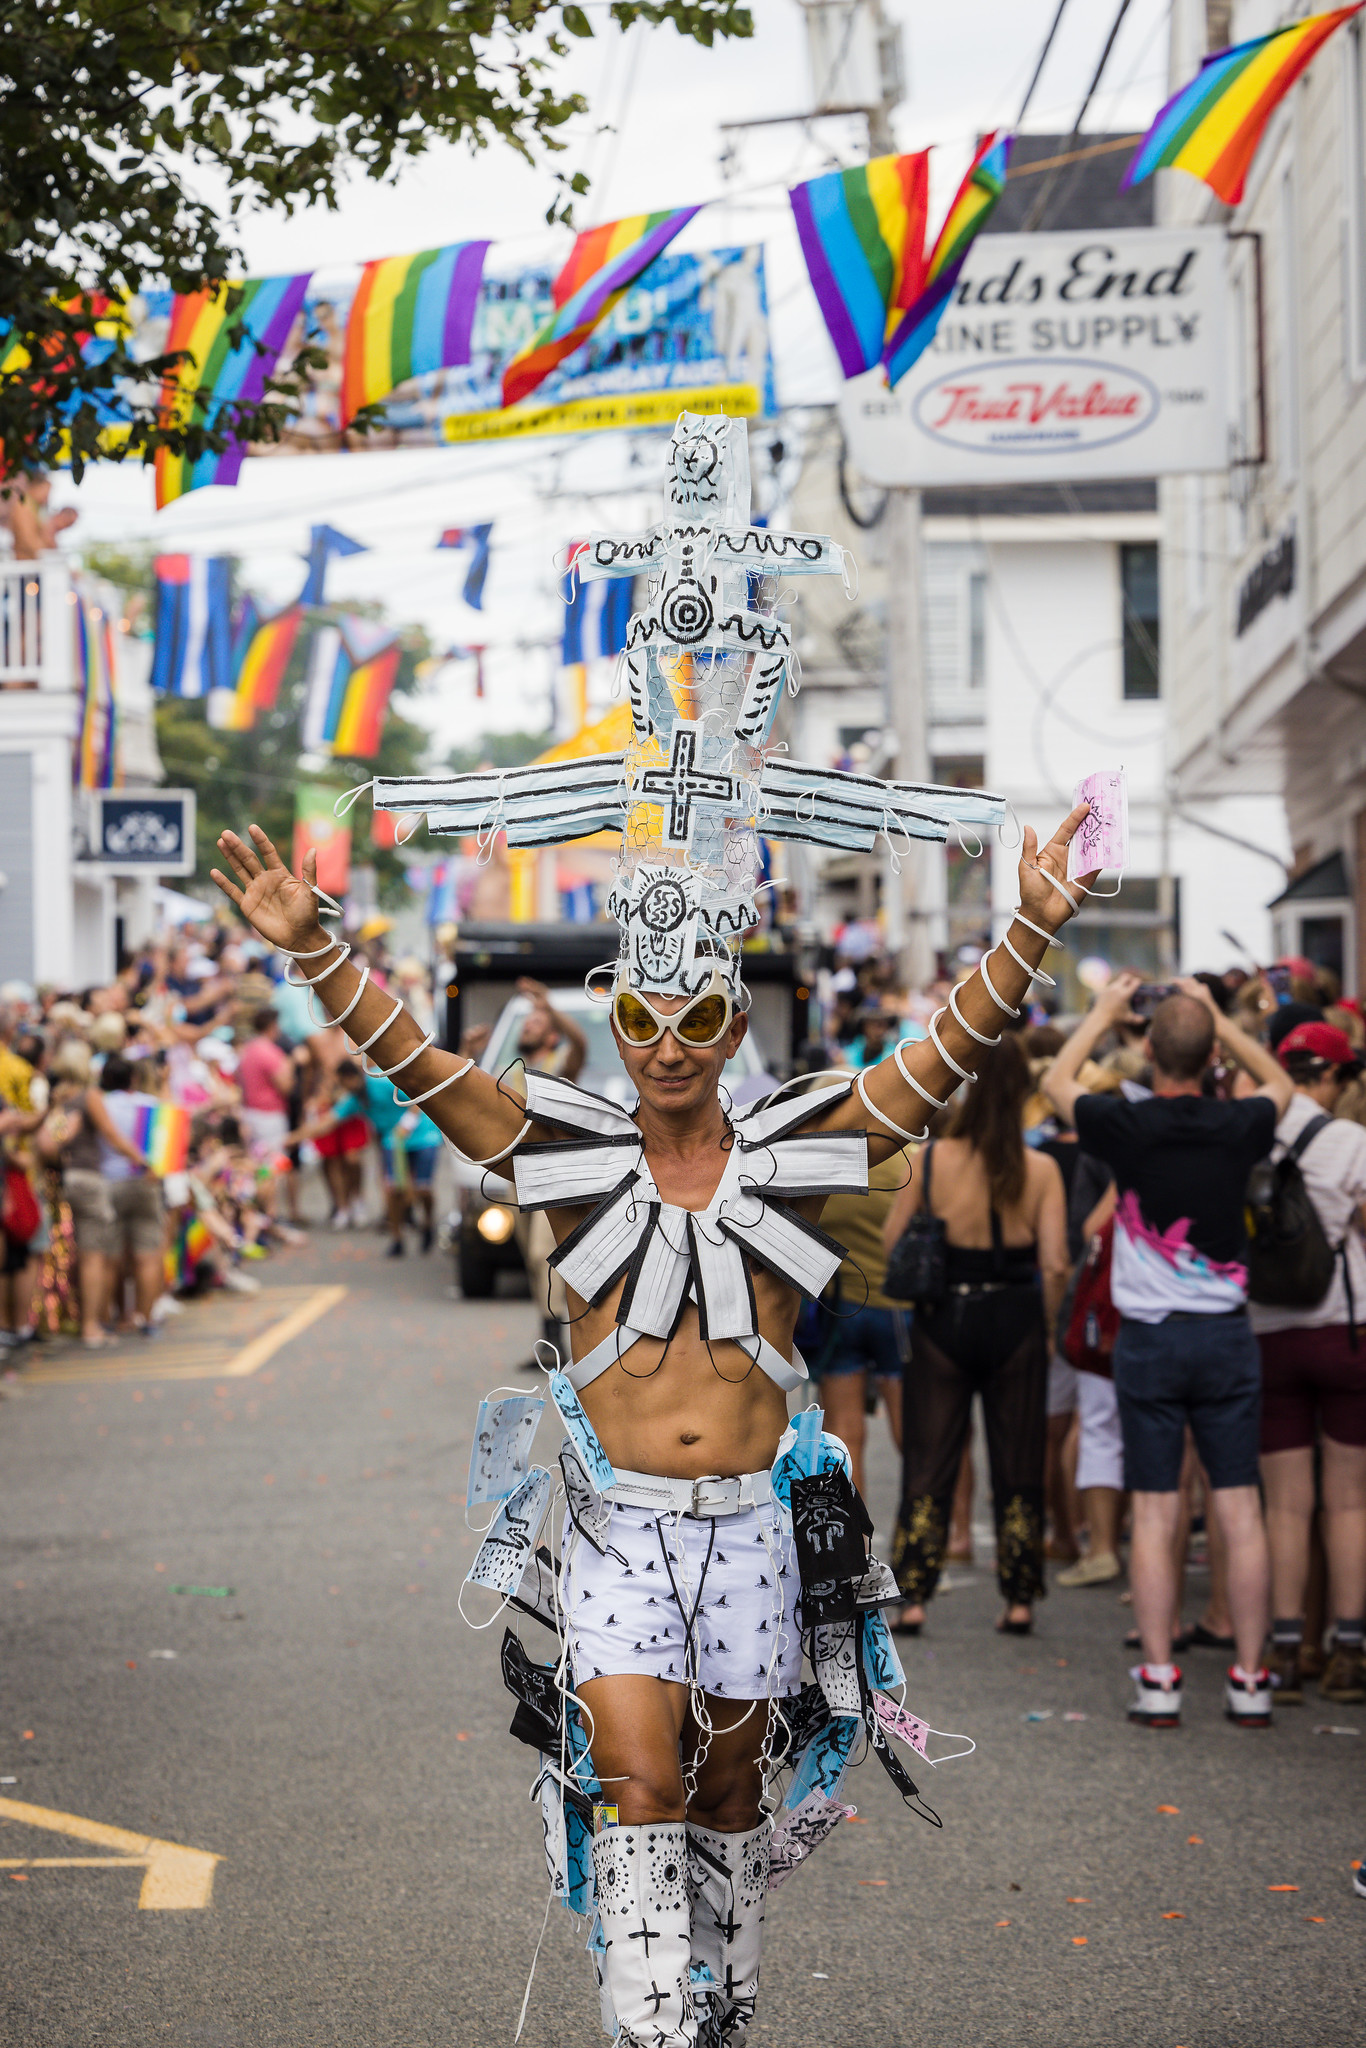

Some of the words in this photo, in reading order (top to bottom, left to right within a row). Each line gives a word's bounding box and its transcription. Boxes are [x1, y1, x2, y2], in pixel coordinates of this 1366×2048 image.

[1059, 243, 1199, 303] End
[933, 321, 1015, 354] INE
[1031, 311, 1199, 353] SUPPLY
[933, 385, 1021, 427] True
[1006, 381, 1139, 425] Value
